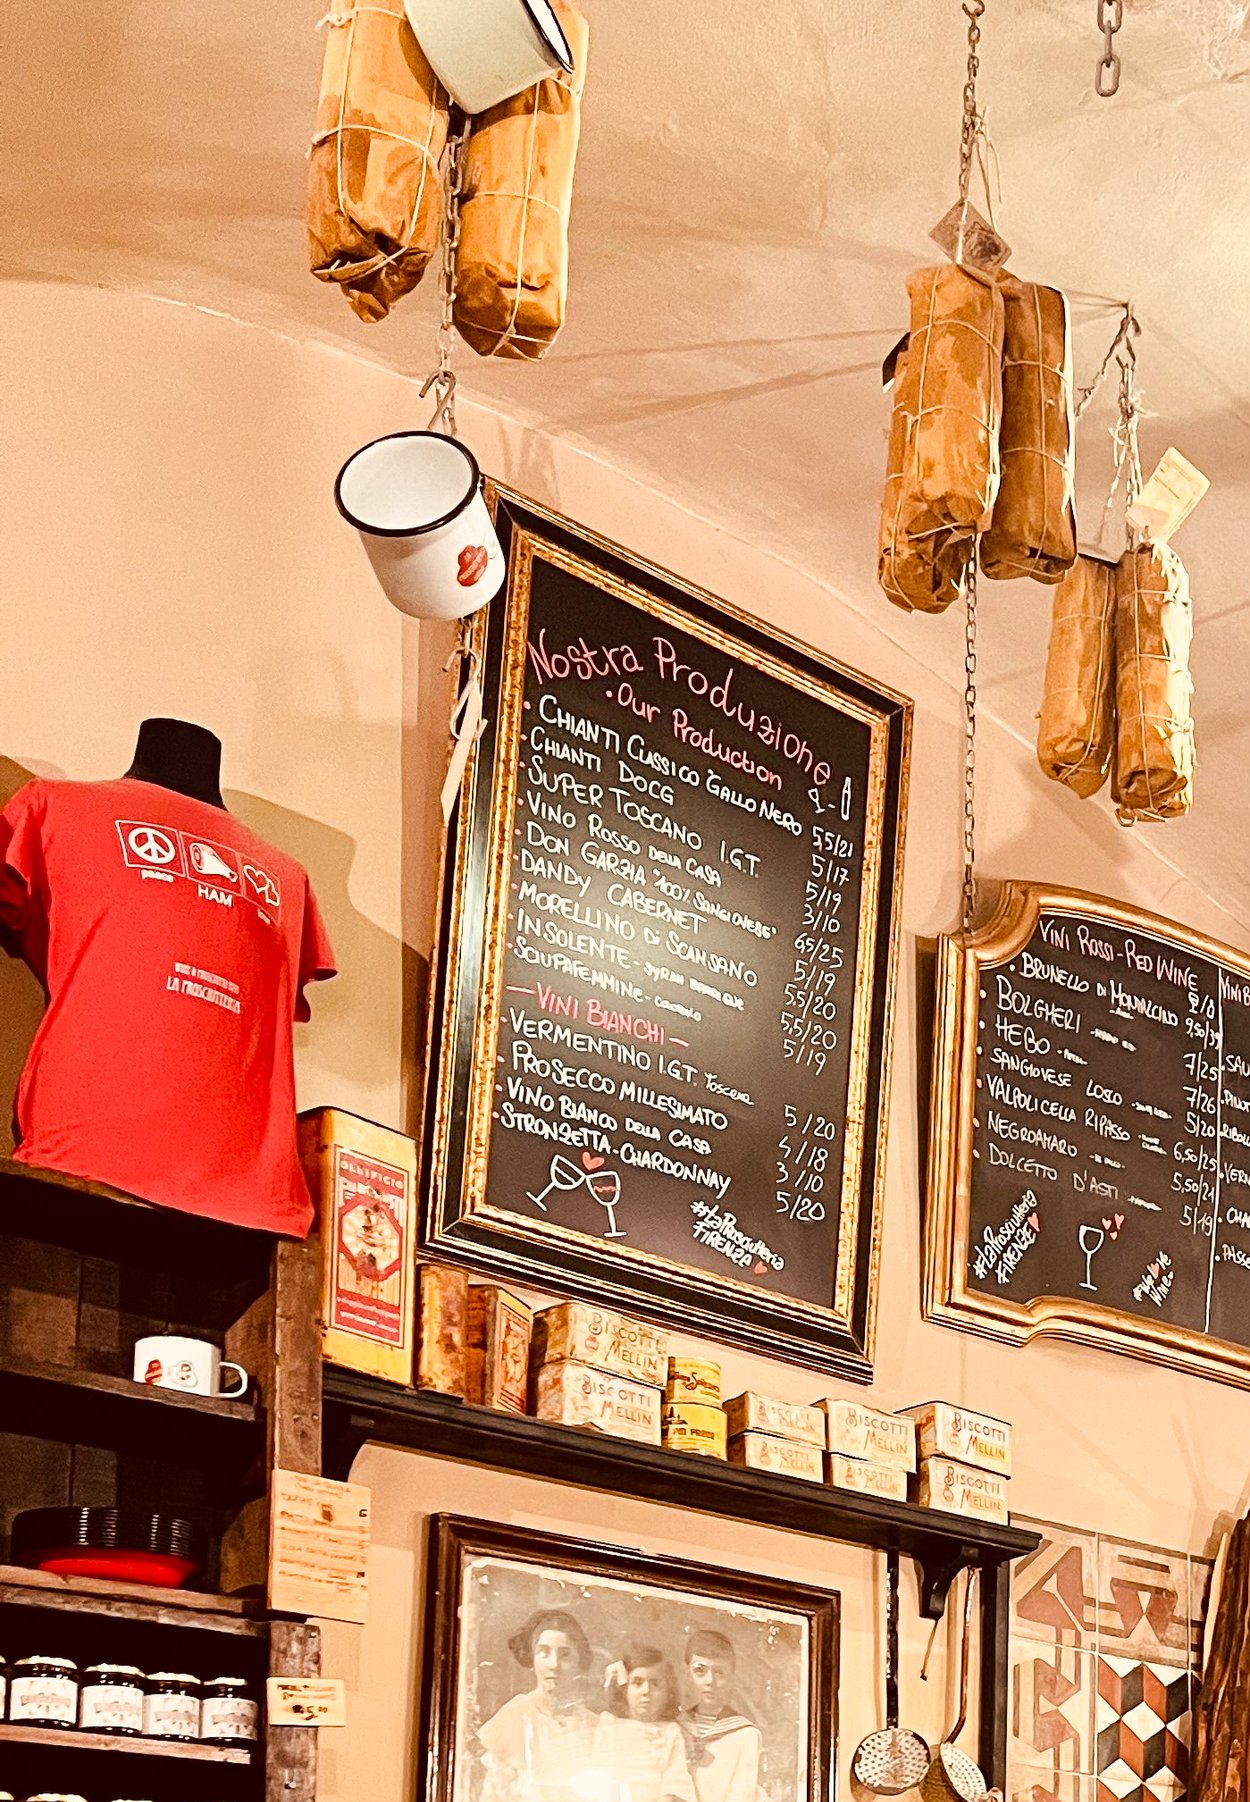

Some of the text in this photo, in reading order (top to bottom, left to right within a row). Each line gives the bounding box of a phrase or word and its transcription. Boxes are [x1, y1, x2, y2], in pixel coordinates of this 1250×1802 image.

[527, 628, 832, 787] Nostra Produzione
[616, 683, 783, 790] Our Production
[539, 694, 621, 753] CHIANTI
[626, 733, 700, 787] CLASSICO
[527, 757, 842, 915] SUPER TOSCANO I.G.T. 5/19
[529, 726, 850, 886] CHIANTI DOCG 5/17
[526, 820, 569, 857] DON
[526, 790, 576, 830] VINO
[588, 817, 641, 857] ROSSO
[685, 857, 722, 887] CASA
[802, 904, 841, 933] 3/10
[197, 884, 234, 908] HAM
[521, 848, 836, 996] DANDY CABERNET 5/19
[517, 908, 631, 970] INSOLENTE
[518, 880, 636, 941] MORELLINO
[665, 931, 758, 987] SCANSANO
[1039, 919, 1199, 992] VINI ROSSI RED WINE
[166, 975, 180, 992] LA
[1019, 952, 1090, 993] BRUNELLO
[1221, 975, 1242, 1001] VINI
[535, 981, 579, 1019] VINI
[586, 999, 666, 1047] BIANCHI
[996, 975, 1219, 1082] BOLGHERI 7/25
[508, 1007, 652, 1072] VERMENTINO
[784, 1103, 836, 1141] 5/20
[511, 1039, 616, 1097] PROSECCO
[620, 1077, 729, 1131] MILLESIMATO
[783, 1039, 826, 1076] 5/19
[995, 1014, 1050, 1054] HEBO
[1183, 1086, 1216, 1114] 7/26
[986, 1074, 1077, 1122] VALPOLICELLA
[1084, 1109, 1131, 1142] RIPASSO
[990, 1047, 1072, 1088] SANGIOVESE
[1184, 1112, 1216, 1138] 5/20
[507, 1076, 824, 1193] VINO BIANCO DELLA CASA 3/10
[987, 1110, 1078, 1157] NEGROAMARO
[775, 1191, 826, 1222] 5/20
[988, 1142, 1058, 1181] DOLCETTO
[1179, 1207, 1214, 1238] 5/19
[605, 1340, 658, 1371] MELLIN
[582, 1374, 652, 1408] BISCOTTI
[600, 1401, 652, 1425] MELLIN
[846, 1408, 908, 1437] BISCOTTI
[864, 1429, 908, 1455] MELLIN
[952, 1411, 1006, 1442] BISCOTTI
[966, 1434, 1006, 1460] MELLIN
[944, 1466, 1001, 1495] BISCOTTI
[960, 1488, 1001, 1511] MELLIN
